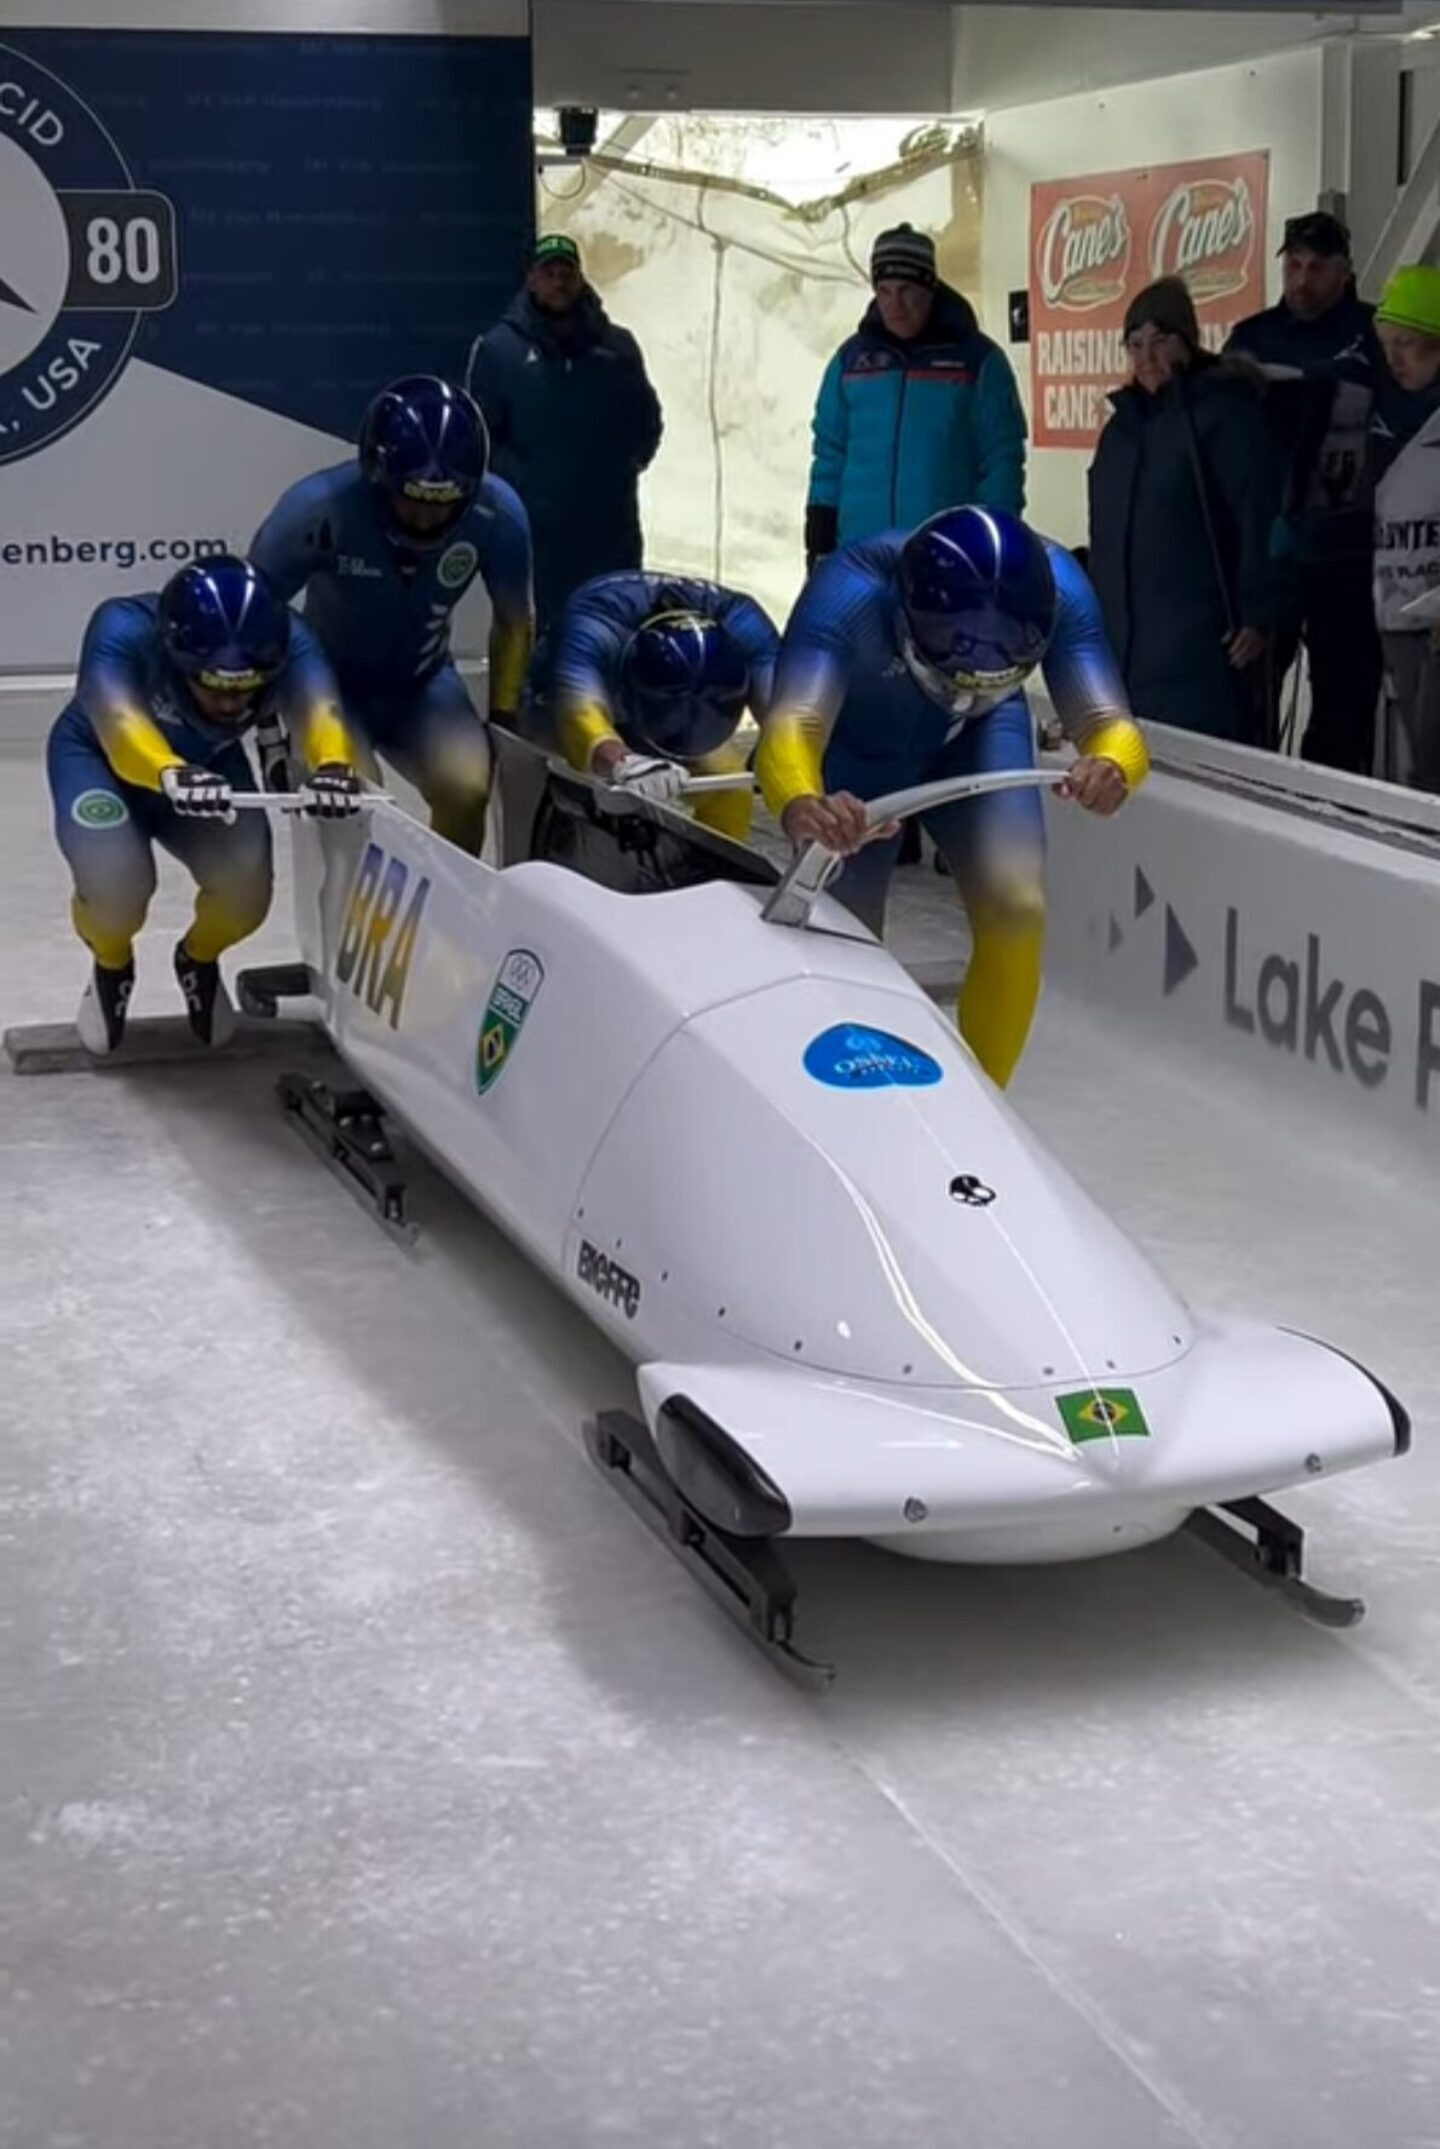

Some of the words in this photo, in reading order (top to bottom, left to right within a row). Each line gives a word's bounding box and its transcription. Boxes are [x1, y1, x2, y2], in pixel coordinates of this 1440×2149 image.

[0, 82, 64, 145] CID
[86, 216, 160, 284] 80
[21, 337, 102, 410] USA
[1036, 328, 1128, 376] RAISING
[2, 536, 229, 569] enberg.com
[336, 842, 431, 1031] BRA
[1224, 905, 1392, 1090] Lake
